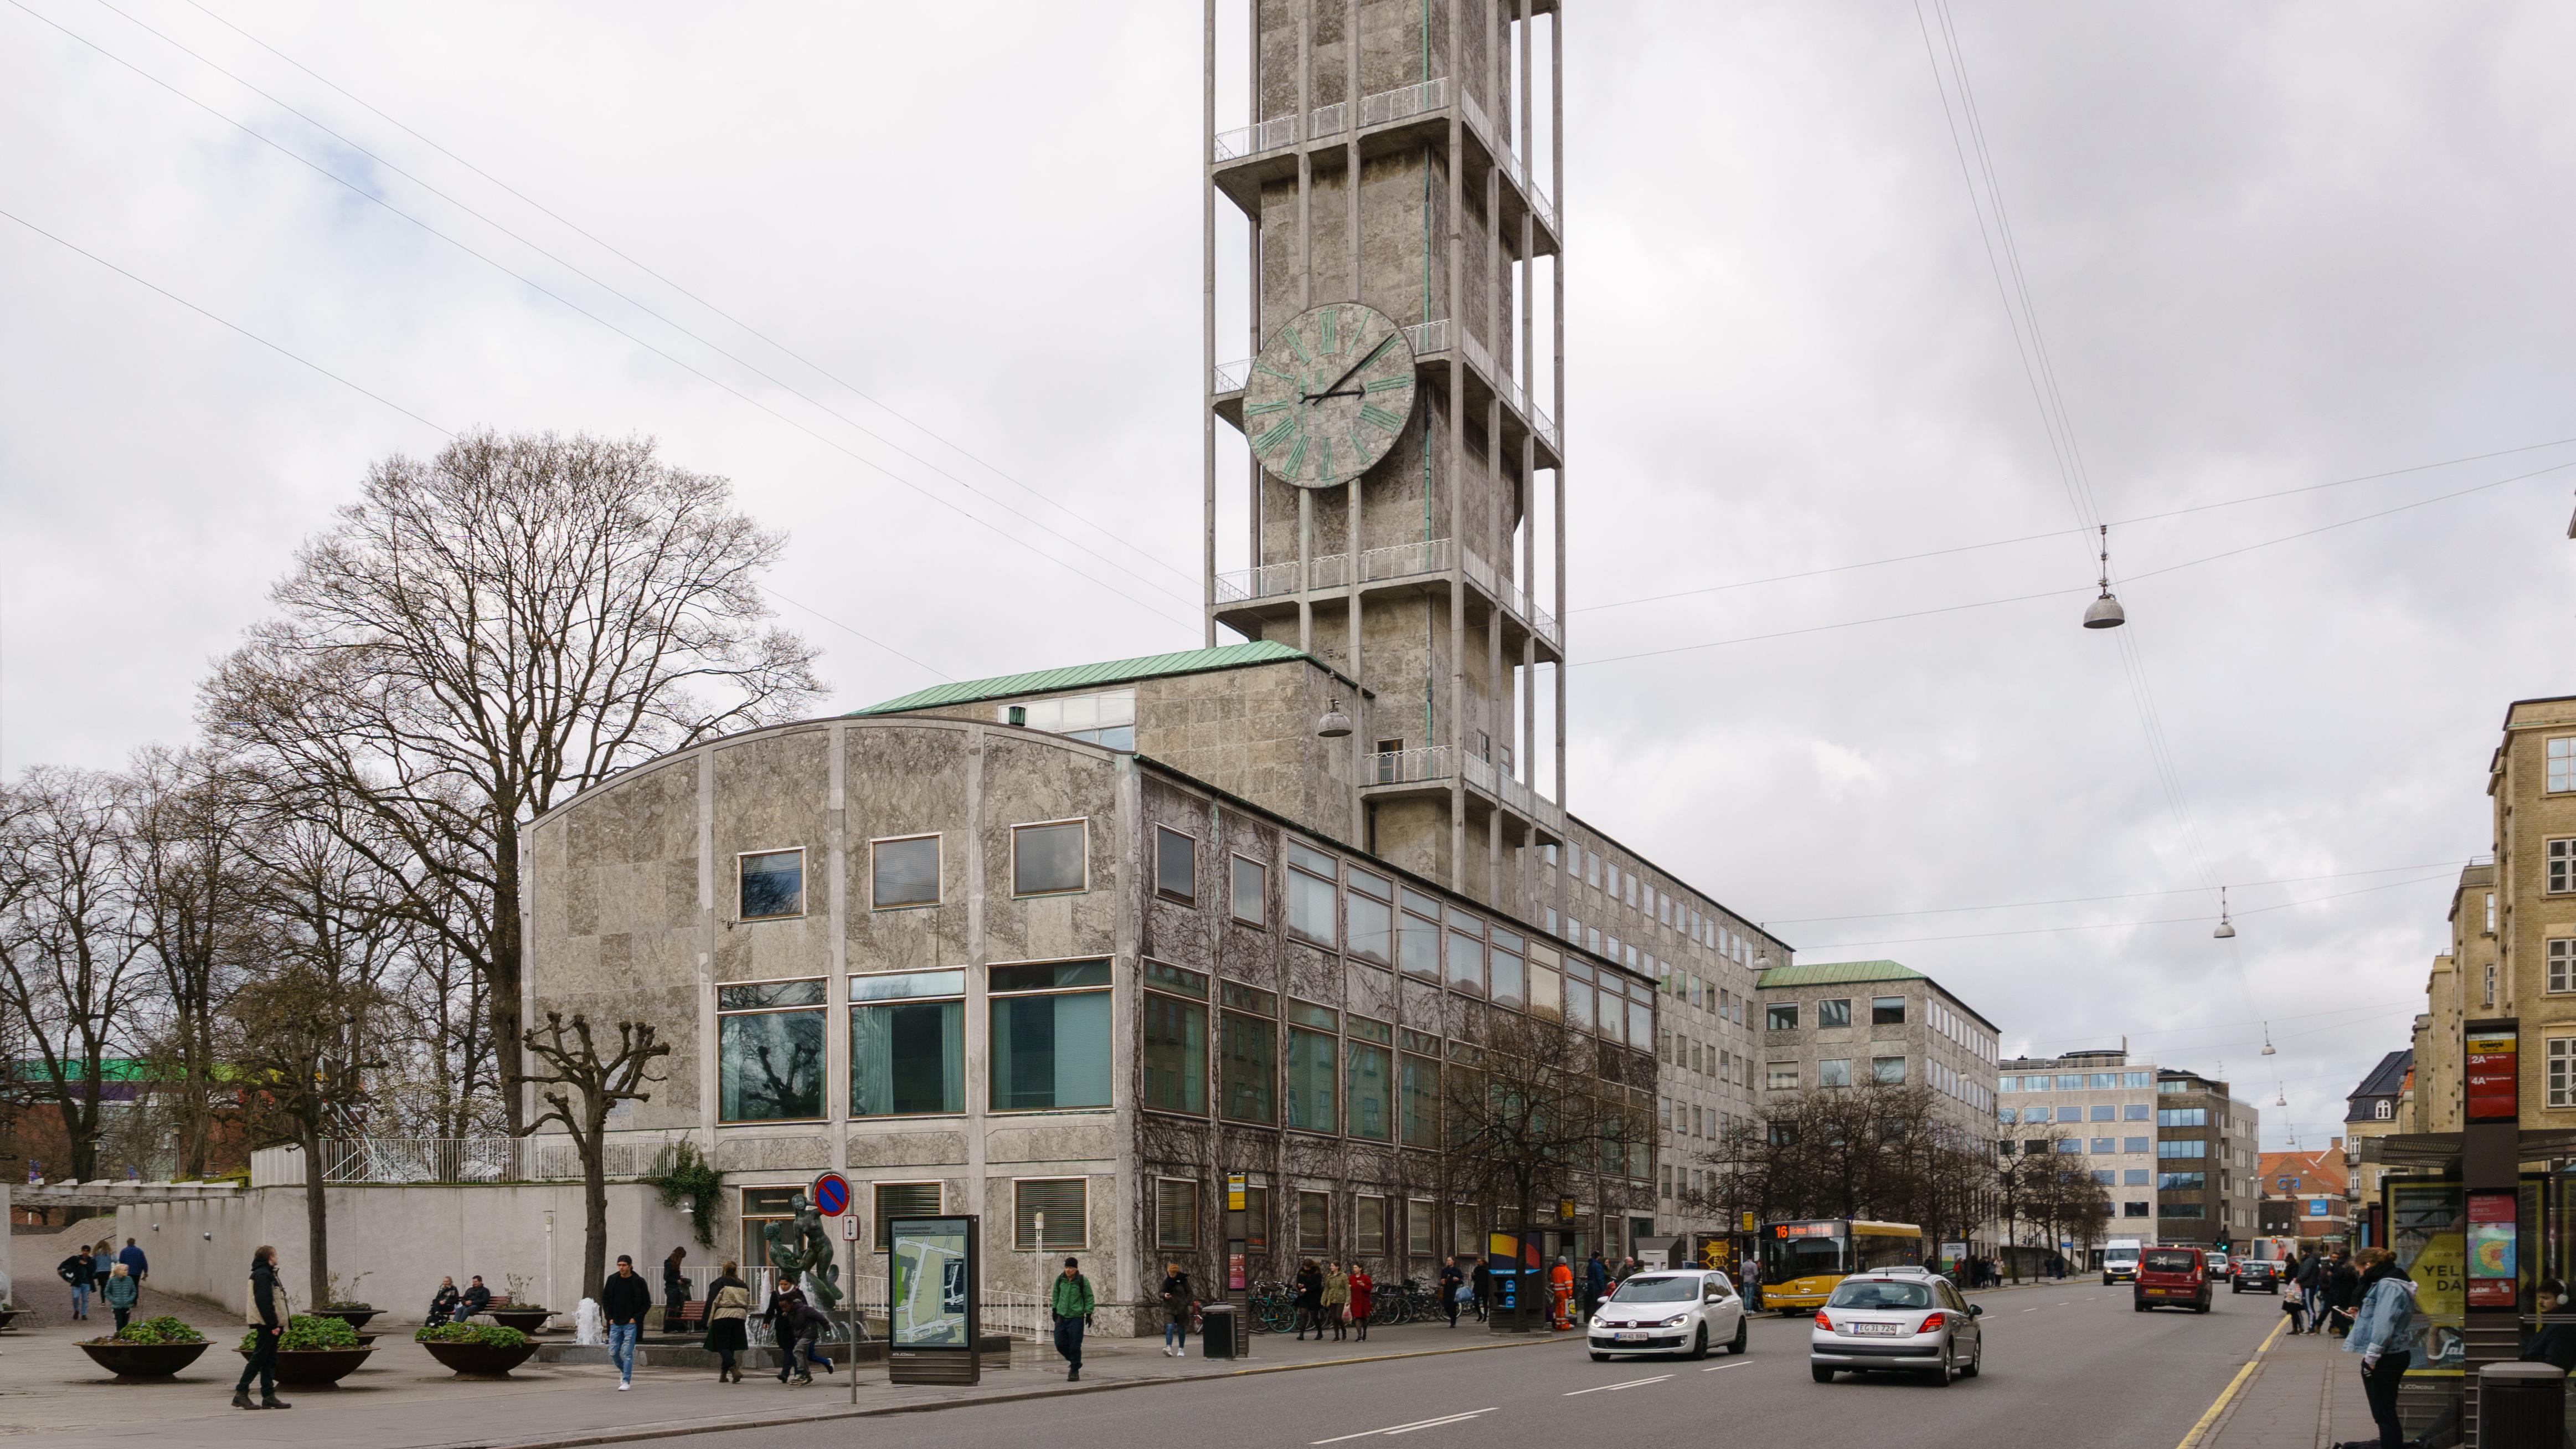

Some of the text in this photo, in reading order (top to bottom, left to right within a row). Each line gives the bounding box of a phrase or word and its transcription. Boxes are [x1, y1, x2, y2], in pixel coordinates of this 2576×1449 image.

[2471, 1055, 2486, 1064] 2A
[2471, 1076, 2486, 1085] 4A
[1775, 1225, 1832, 1239] 16 Holme Parkvej
[2423, 1265, 2464, 1277] YEL
